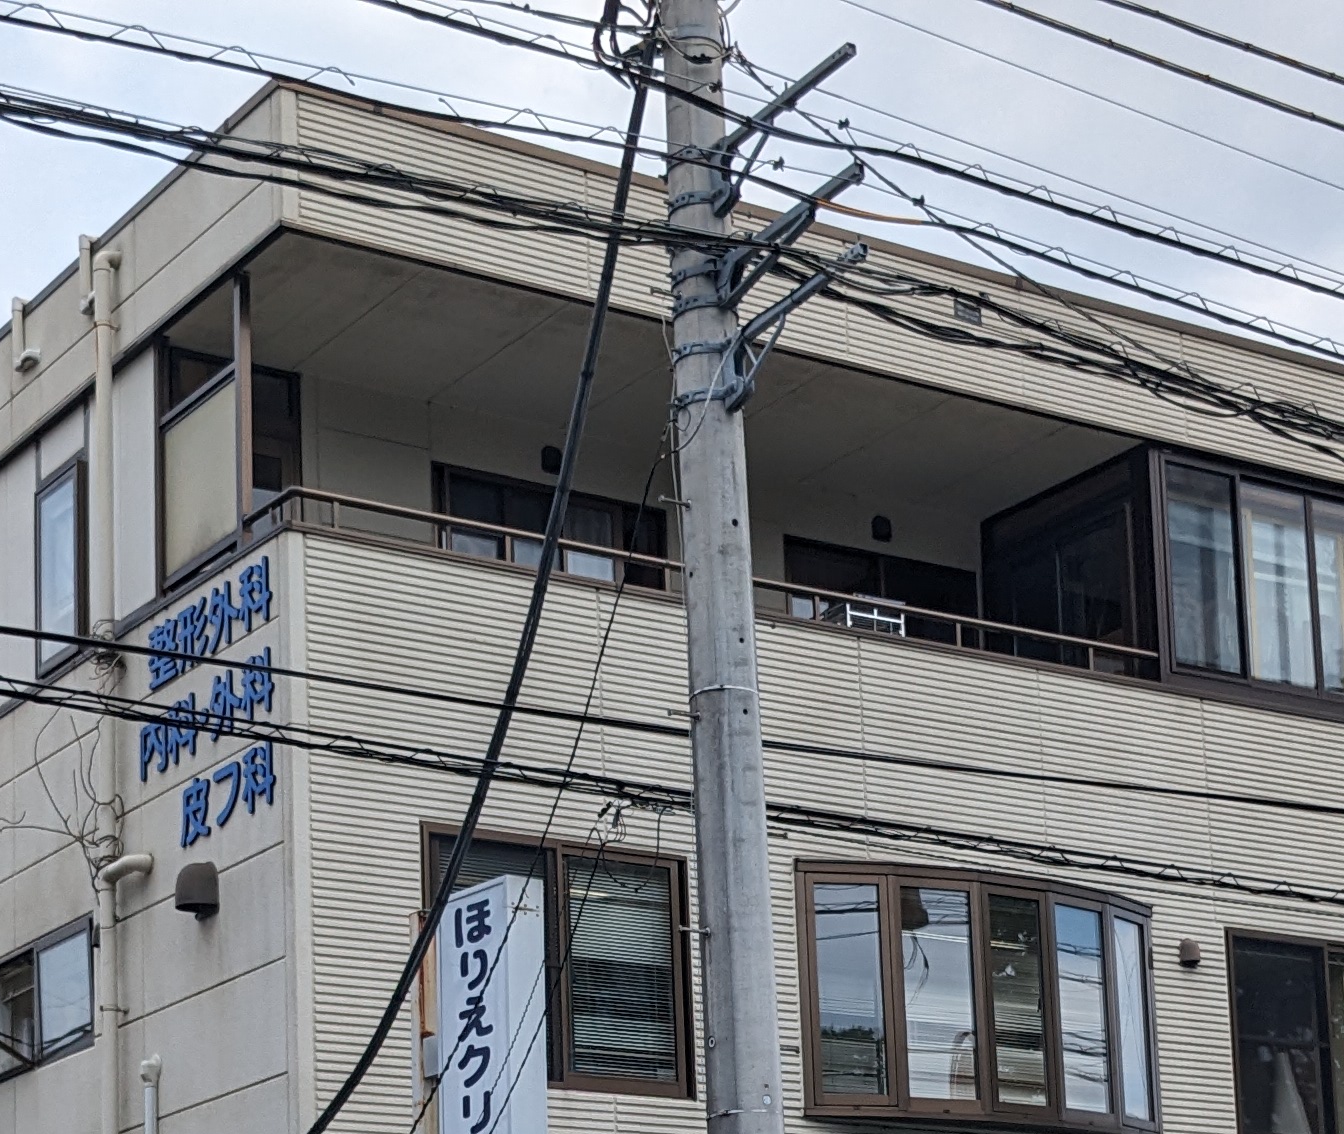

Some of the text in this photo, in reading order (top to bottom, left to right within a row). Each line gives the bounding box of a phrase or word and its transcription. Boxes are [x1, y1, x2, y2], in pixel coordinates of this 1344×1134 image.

[147, 555, 273, 691] 整形外科
[180, 740, 277, 848] 皮フ科
